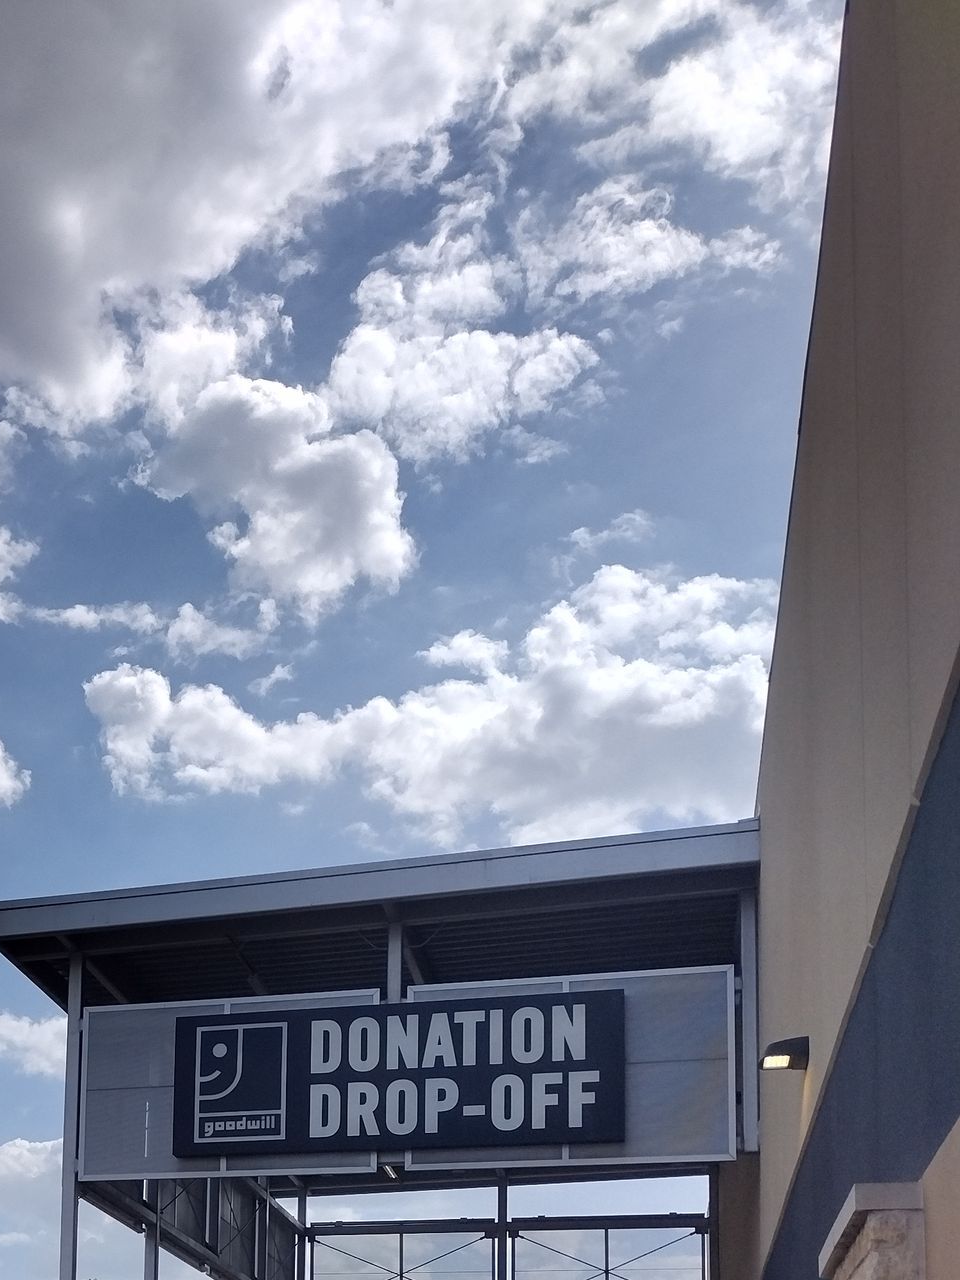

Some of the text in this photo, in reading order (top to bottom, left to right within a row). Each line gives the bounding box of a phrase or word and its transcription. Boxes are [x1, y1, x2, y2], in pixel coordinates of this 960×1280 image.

[310, 1003, 586, 1074] DONATION
[204, 1115, 275, 1137] goodwill
[309, 1070, 600, 1138] DROP-OFF
